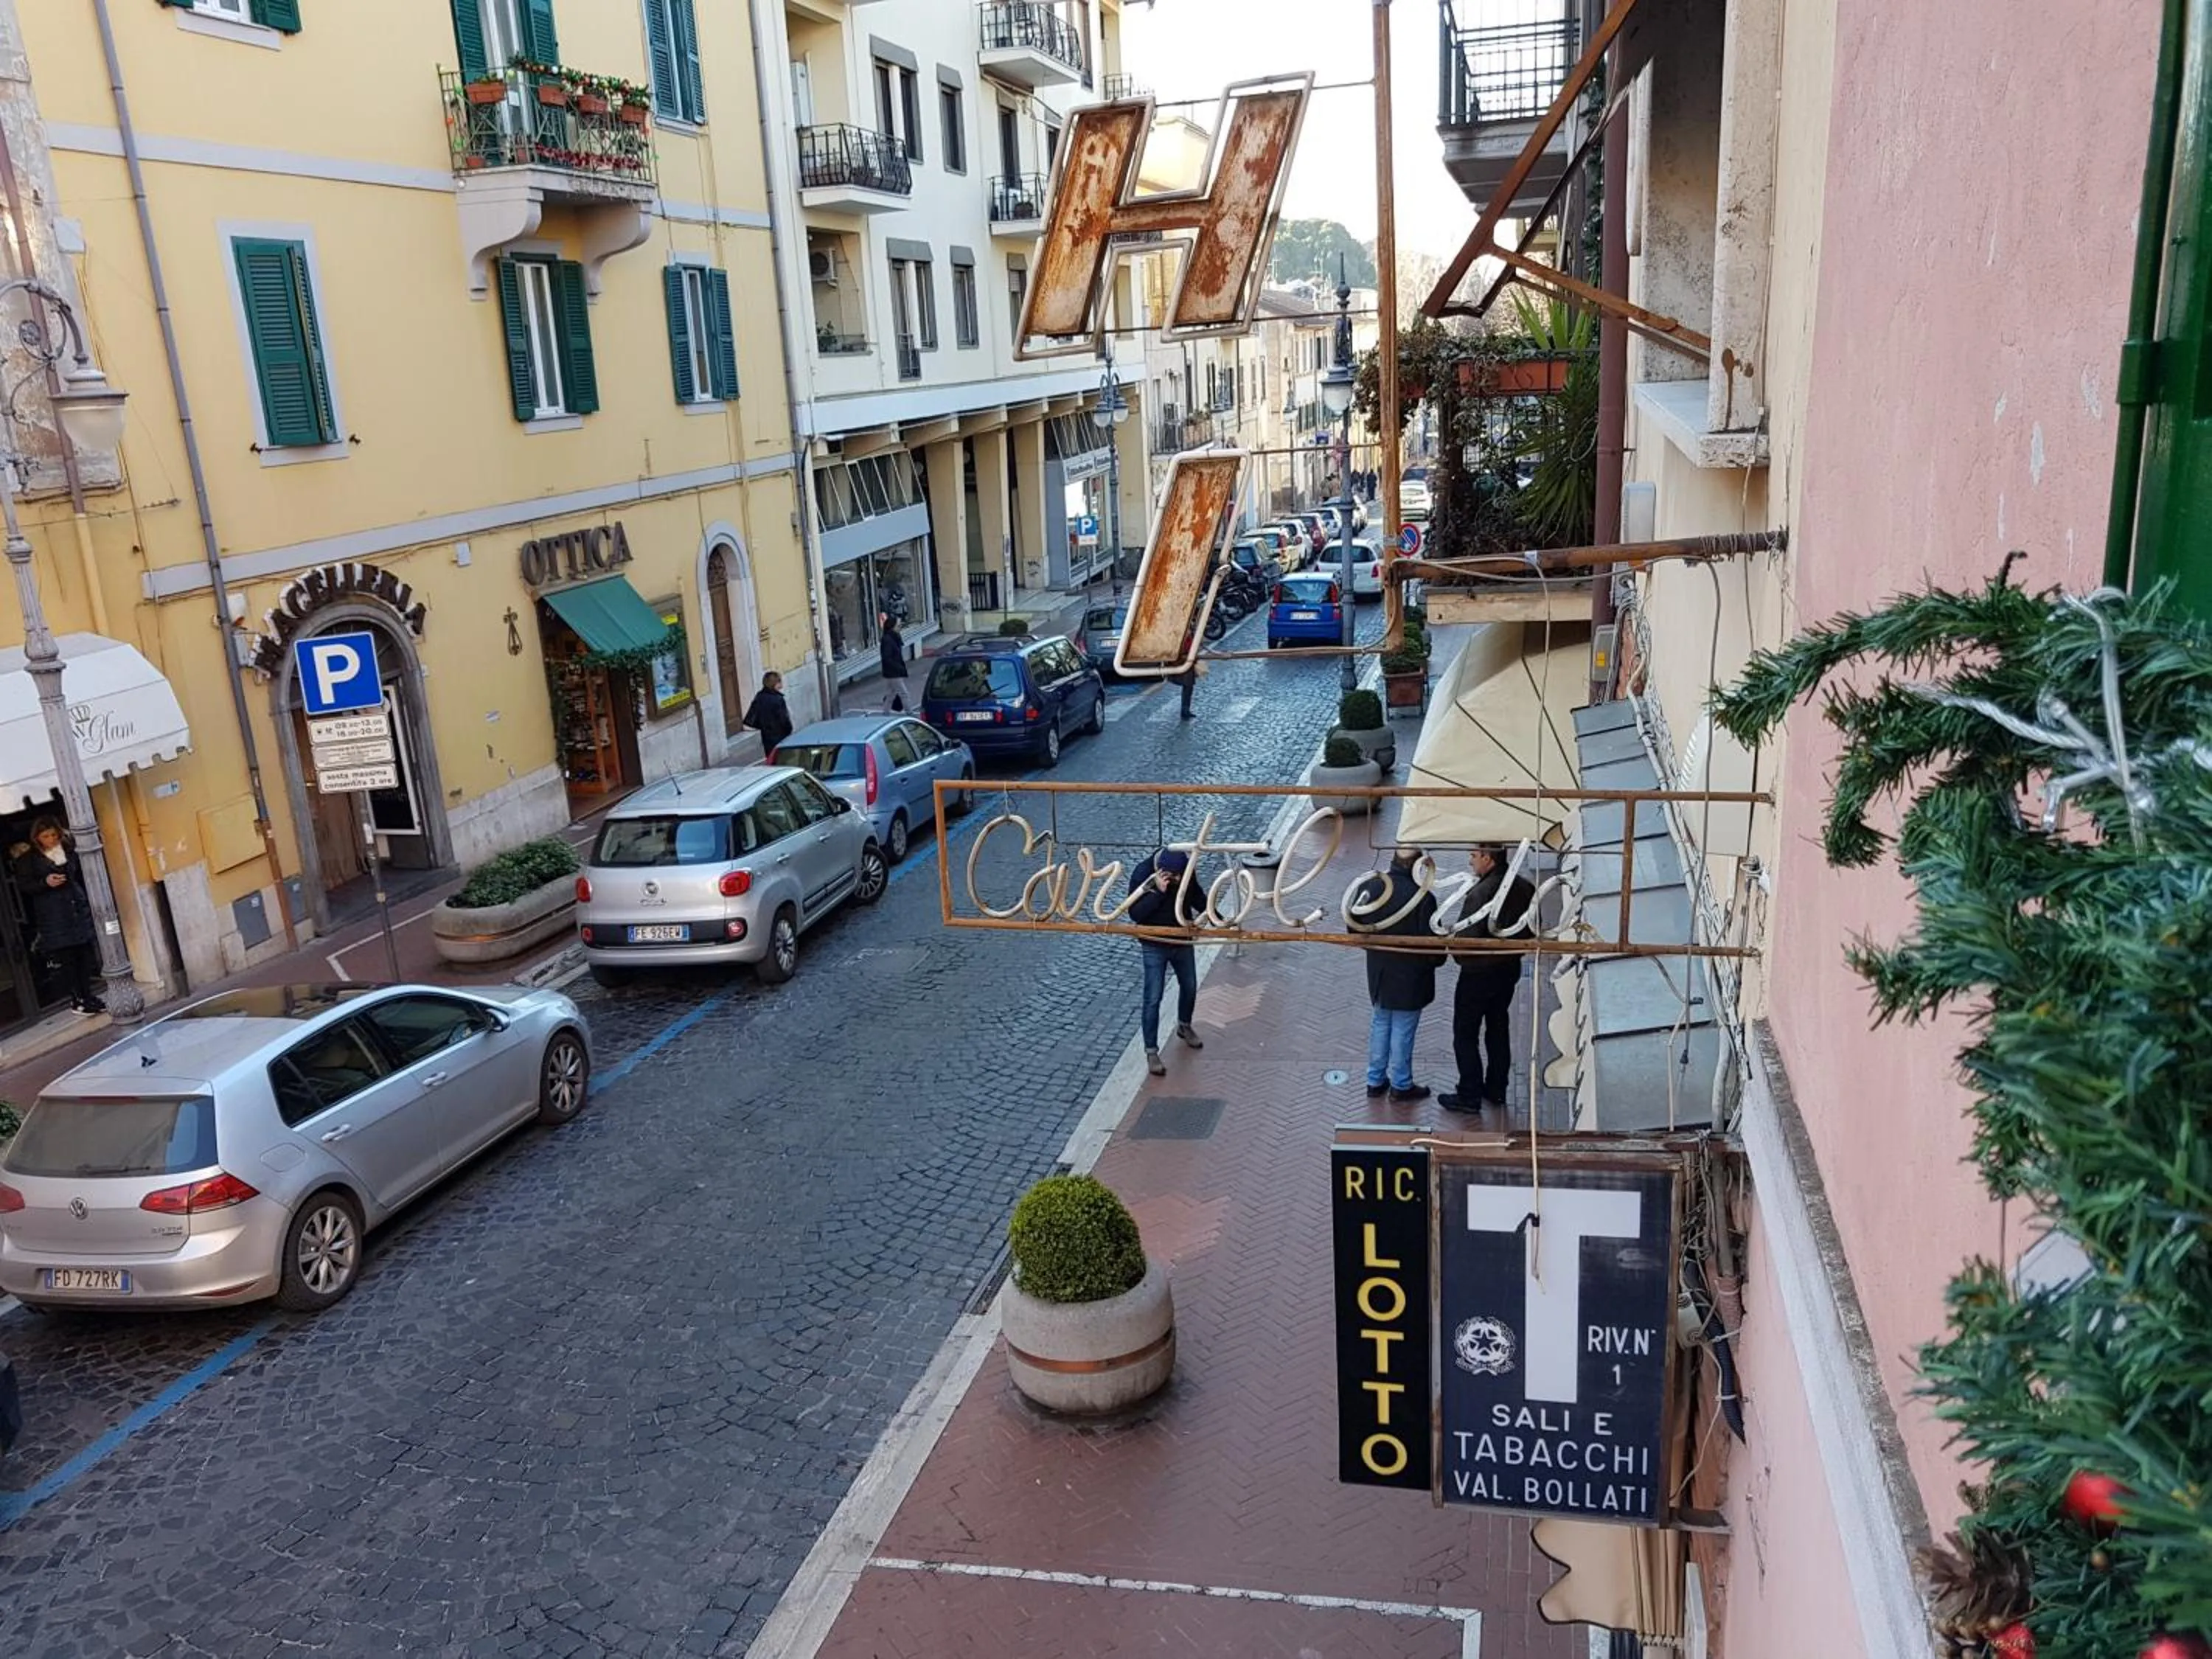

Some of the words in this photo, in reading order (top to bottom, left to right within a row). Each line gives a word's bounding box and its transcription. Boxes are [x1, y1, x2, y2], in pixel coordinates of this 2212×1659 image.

[1080, 518, 1093, 534] P
[521, 521, 634, 586] OTTICA
[248, 563, 427, 678] MACELLERIA
[313, 644, 361, 706] P
[54, 1270, 70, 1287] FD
[75, 1270, 119, 1288] 727RK
[1466, 1183, 1641, 1404] T
[1357, 1222, 1408, 1476] LOTTO
[1612, 1365, 1621, 1385] 1
[1492, 1404, 1571, 1432] SALI
[1593, 1412, 1613, 1436] E
[1453, 1430, 1649, 1475] TABACCHI
[1453, 1471, 1512, 1501] VAL.
[1524, 1480, 1648, 1513] BOLLATI
